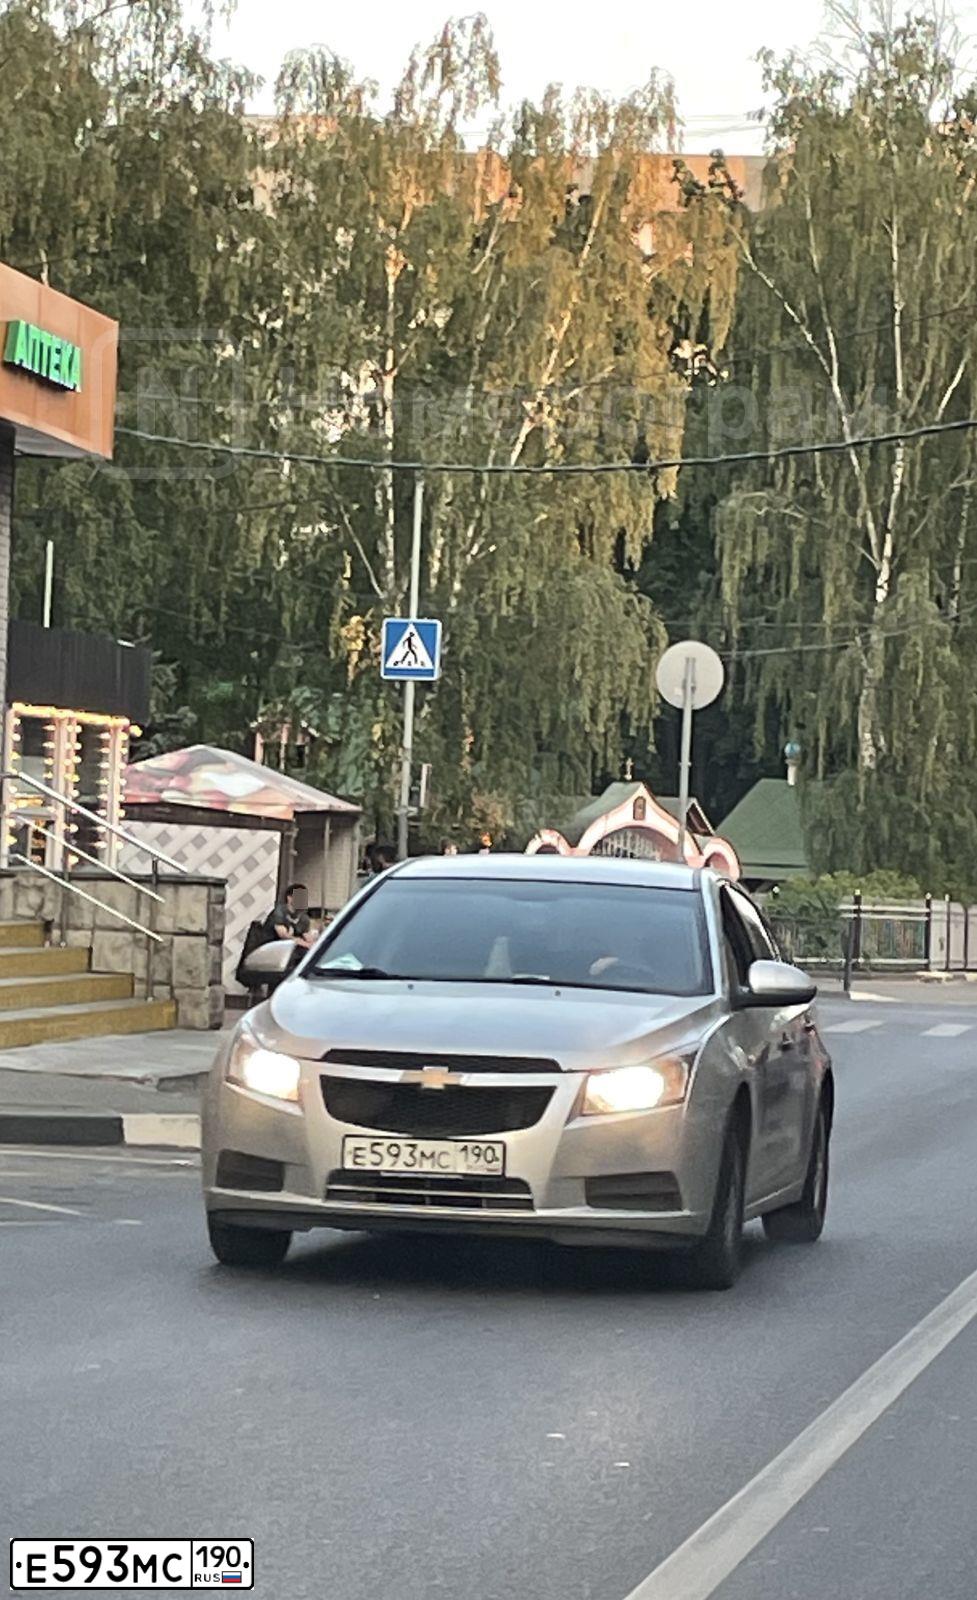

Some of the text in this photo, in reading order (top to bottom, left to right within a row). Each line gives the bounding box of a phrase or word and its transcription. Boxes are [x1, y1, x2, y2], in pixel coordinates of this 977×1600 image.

[8, 319, 82, 393] АПТЕКА
[352, 1142, 497, 1169] Е593МС 190
